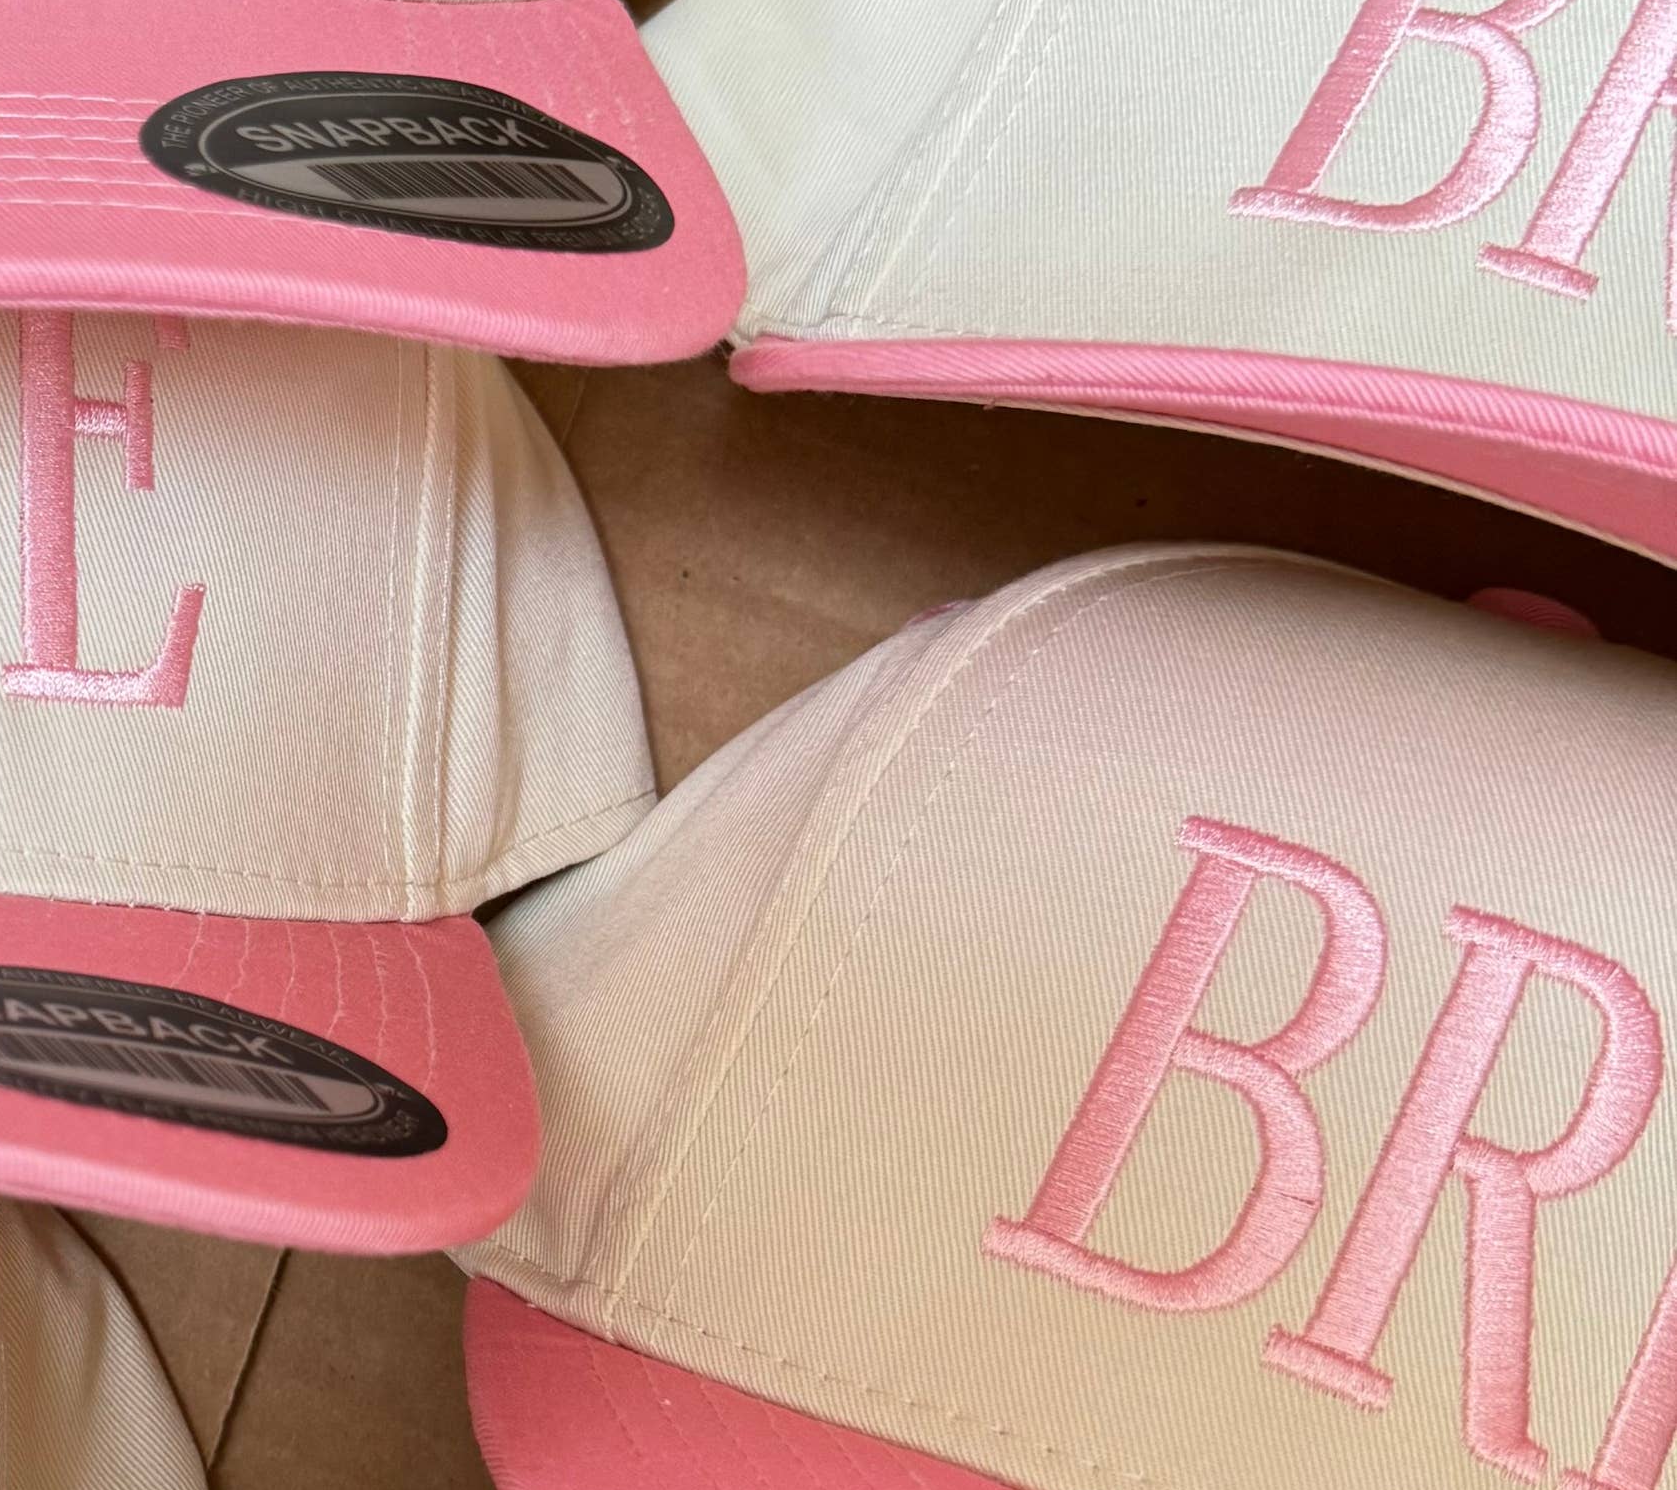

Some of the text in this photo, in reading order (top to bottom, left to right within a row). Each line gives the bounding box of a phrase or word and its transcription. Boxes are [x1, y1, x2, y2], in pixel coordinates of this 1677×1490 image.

[170, 85, 252, 128] PIONEER
[160, 122, 192, 150] THE
[235, 115, 550, 153] SNAPBACK
